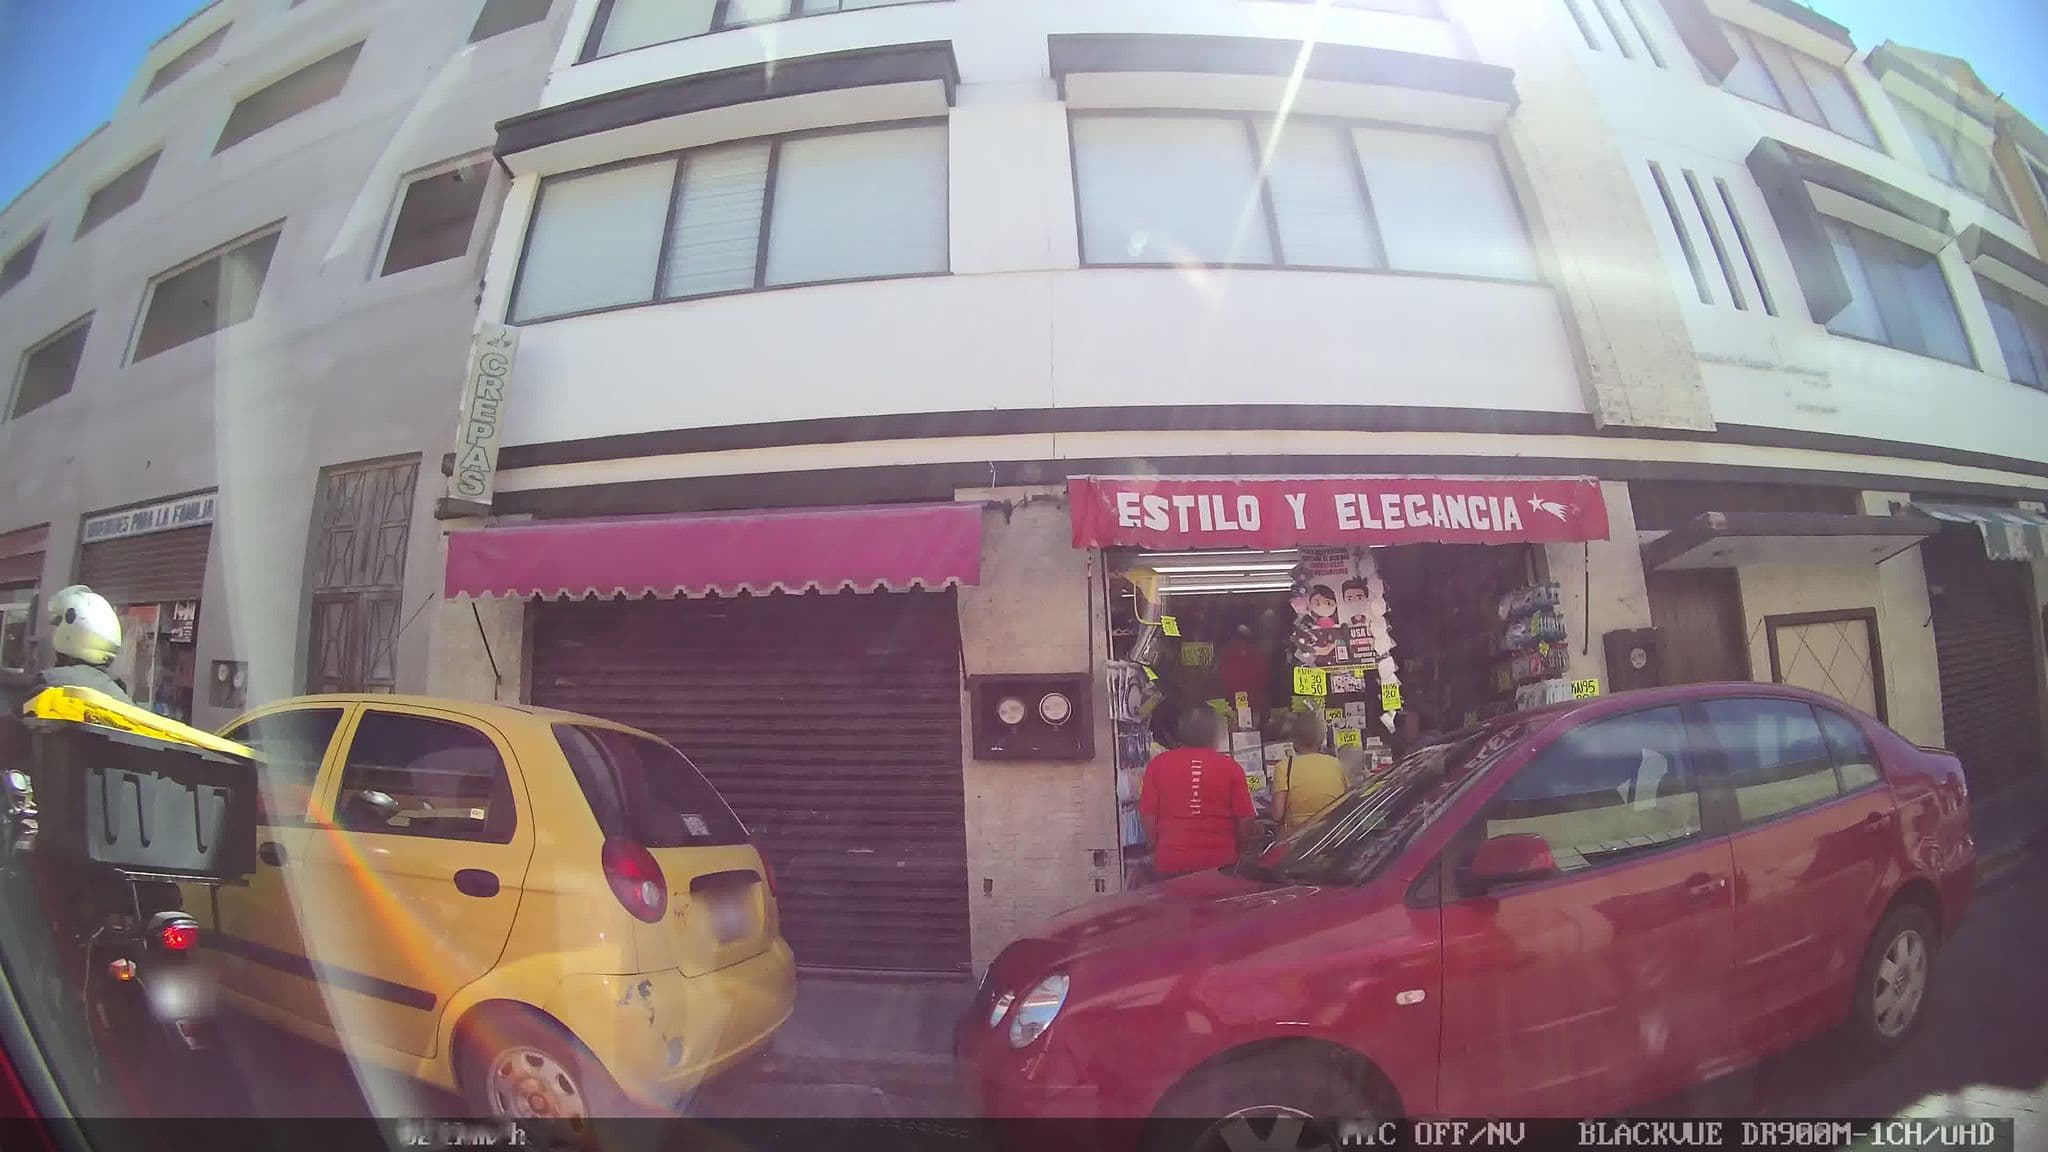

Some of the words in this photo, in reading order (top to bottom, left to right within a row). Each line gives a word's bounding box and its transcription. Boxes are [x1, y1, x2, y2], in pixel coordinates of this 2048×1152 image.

[456, 352, 509, 496] CREPAS
[1116, 491, 1261, 533] ESTILO
[1284, 492, 1307, 530] Y
[1334, 492, 1524, 532] ELEGANCIA
[1570, 680, 1595, 694] KN95
